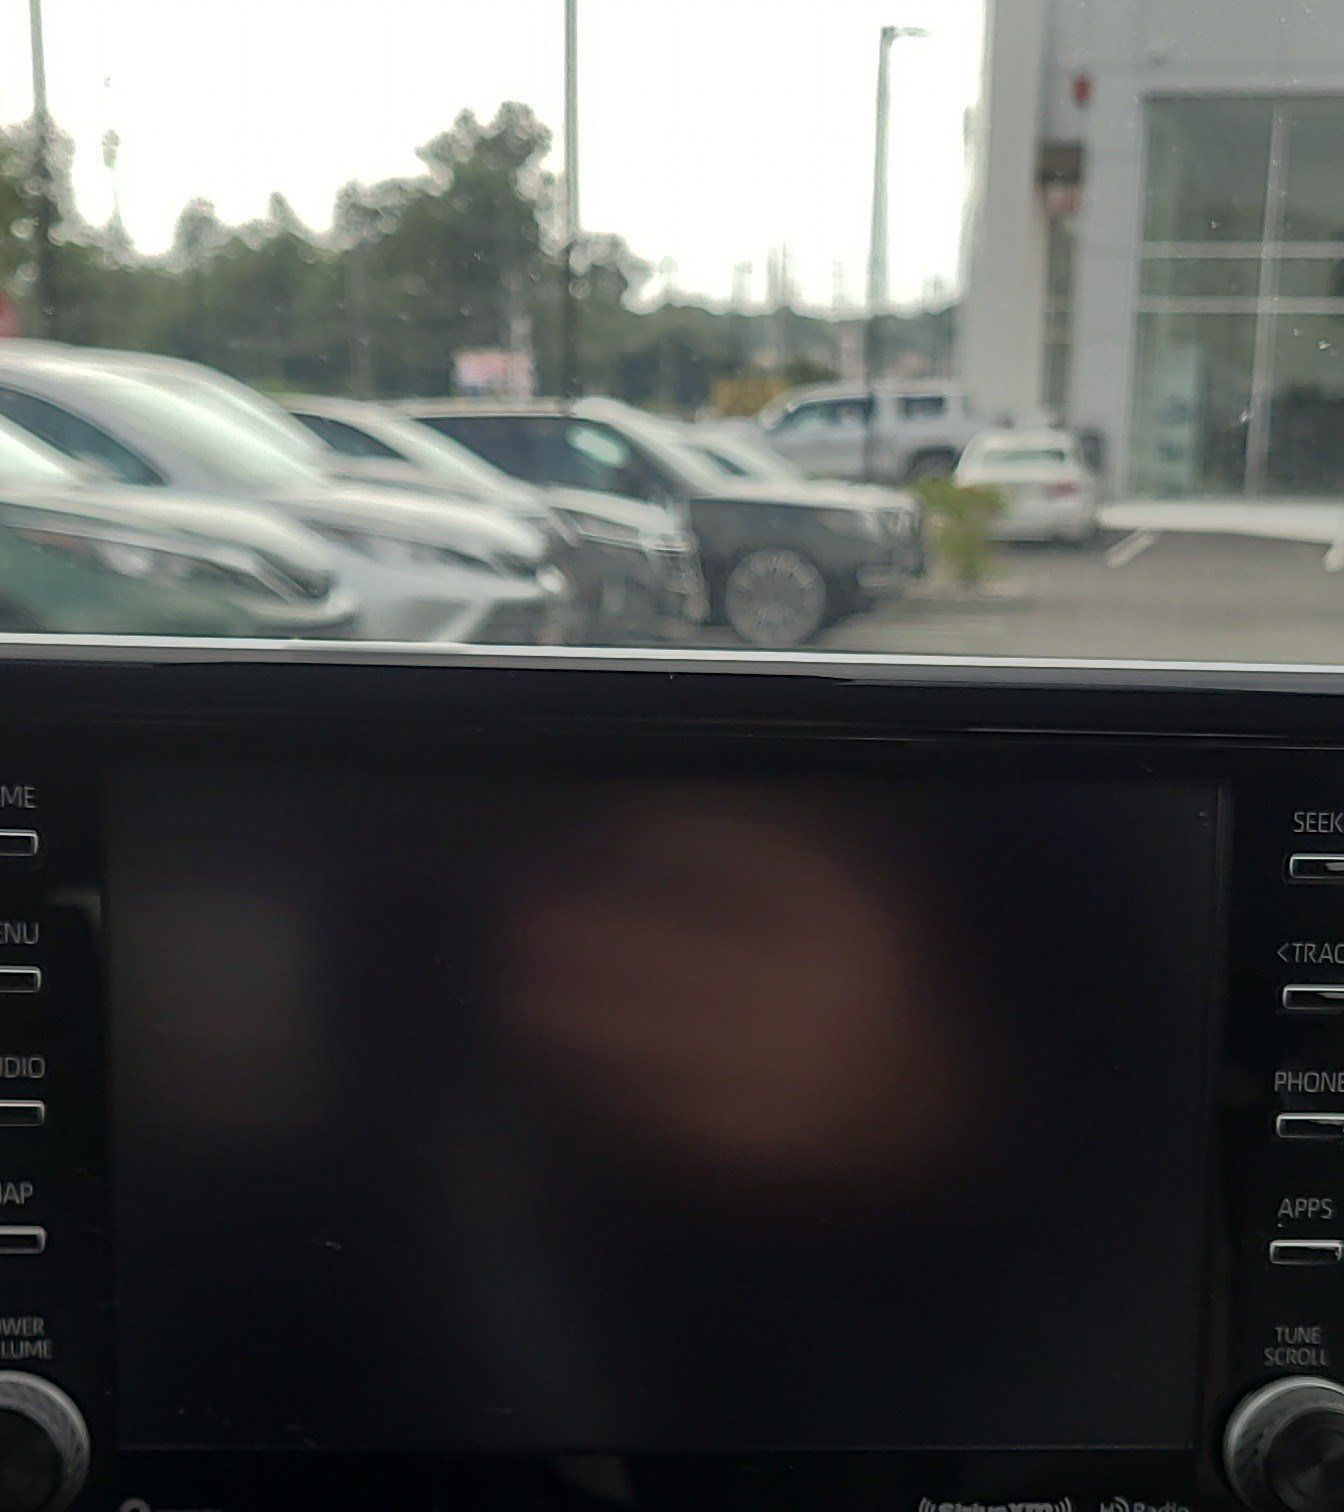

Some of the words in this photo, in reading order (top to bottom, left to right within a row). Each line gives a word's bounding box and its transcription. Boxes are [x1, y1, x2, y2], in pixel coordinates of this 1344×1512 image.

[1277, 1198, 1336, 1220] APPS
[1275, 1326, 1322, 1345] TUNE
[1263, 1347, 1328, 1367] SCROLL
